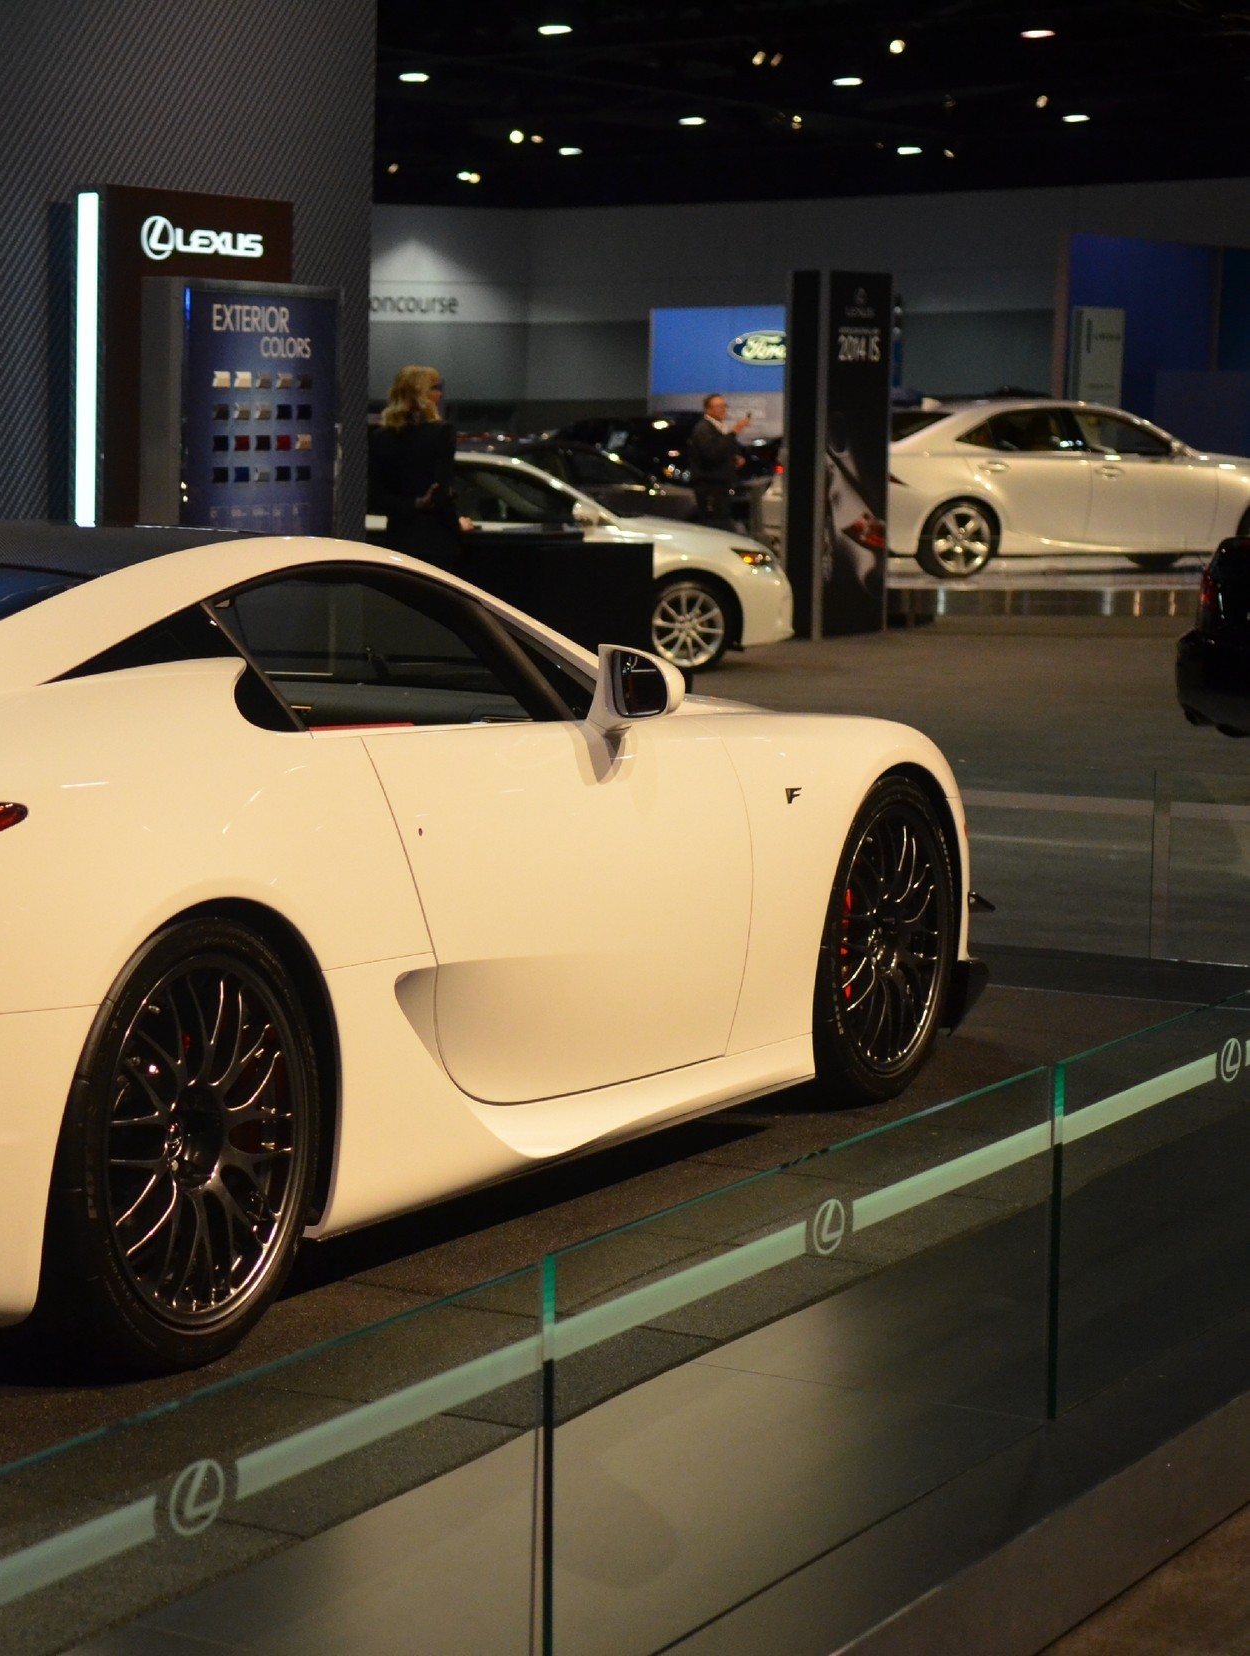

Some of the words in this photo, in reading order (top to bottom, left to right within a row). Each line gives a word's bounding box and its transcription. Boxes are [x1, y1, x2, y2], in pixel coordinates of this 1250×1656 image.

[174, 227, 264, 259] LEXUS
[369, 295, 459, 313] oncourse
[211, 303, 290, 334] EXTERIOR
[259, 335, 312, 359] COLORS
[837, 334, 866, 361] 2014
[868, 334, 881, 361] IS
